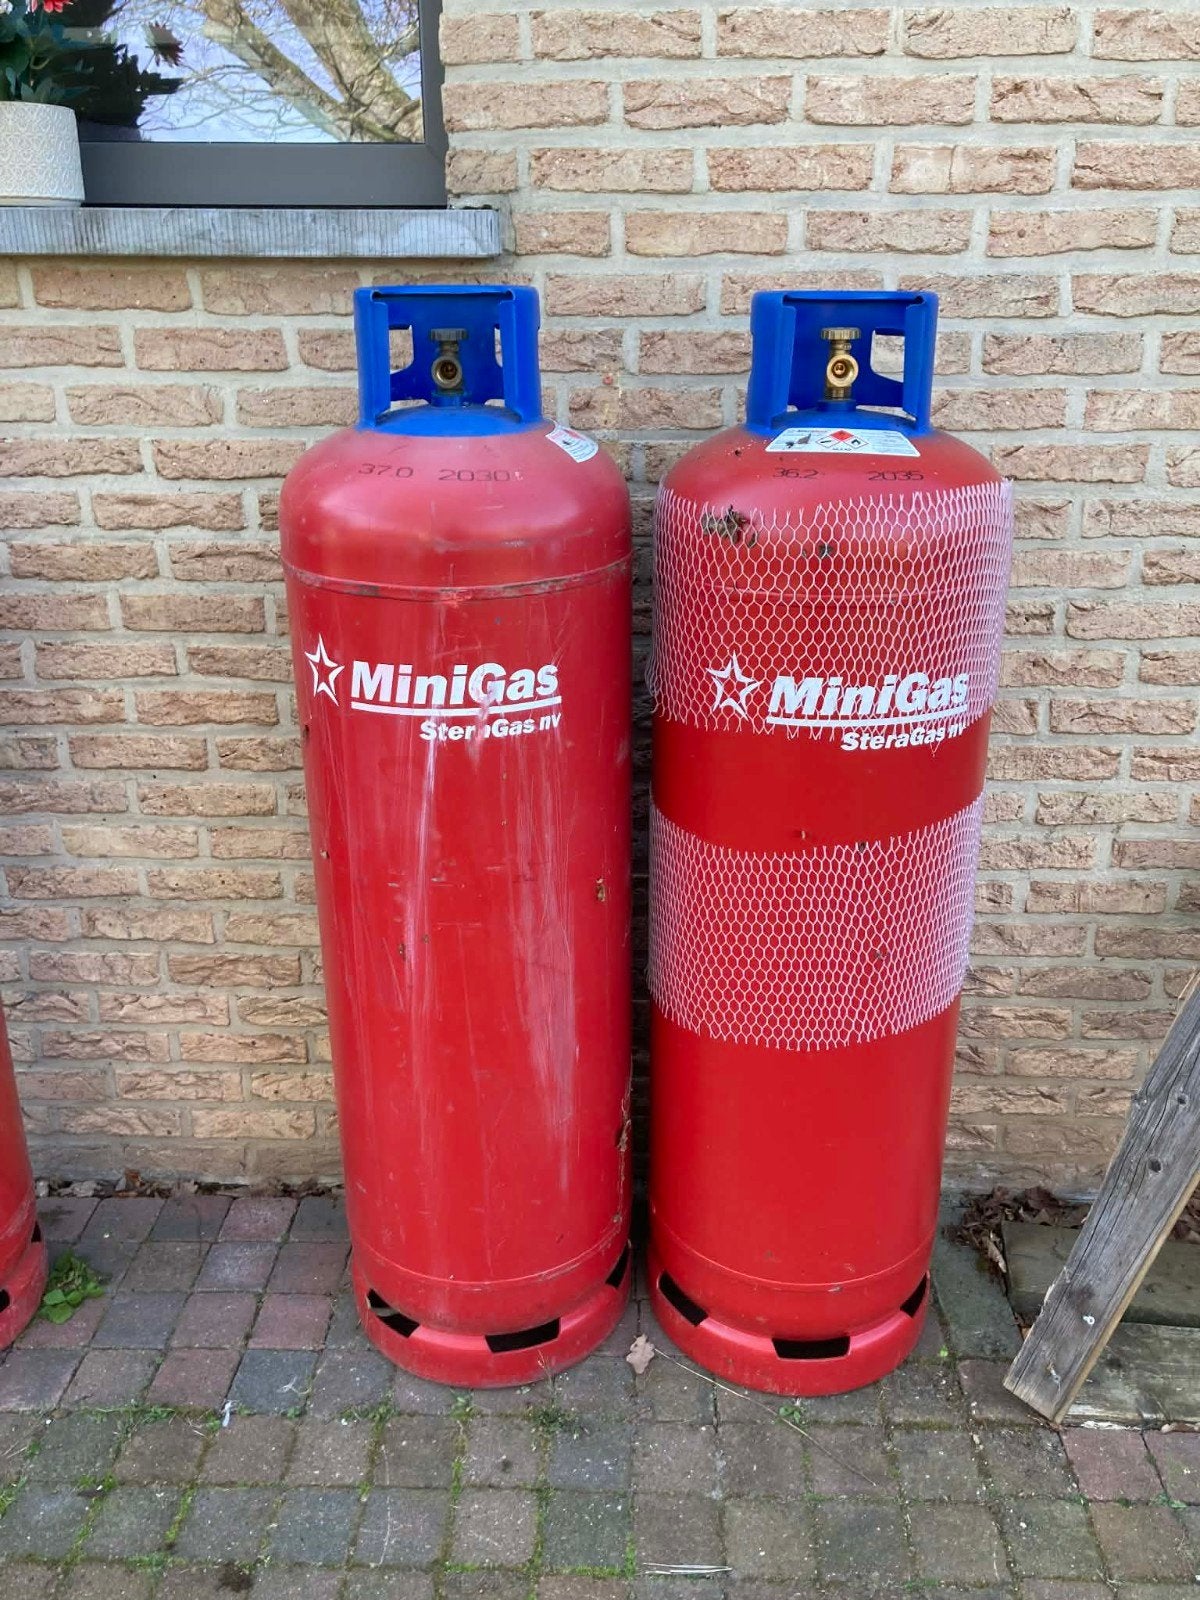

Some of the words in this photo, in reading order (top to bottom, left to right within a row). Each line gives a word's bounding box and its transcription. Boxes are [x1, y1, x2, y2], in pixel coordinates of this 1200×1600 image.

[438, 468, 511, 482] 2030
[772, 467, 819, 479] 36.2
[867, 470, 924, 481] 2035
[351, 660, 559, 705] MiniGas
[768, 671, 969, 715] MiniGas
[840, 726, 944, 750] SteraGas
